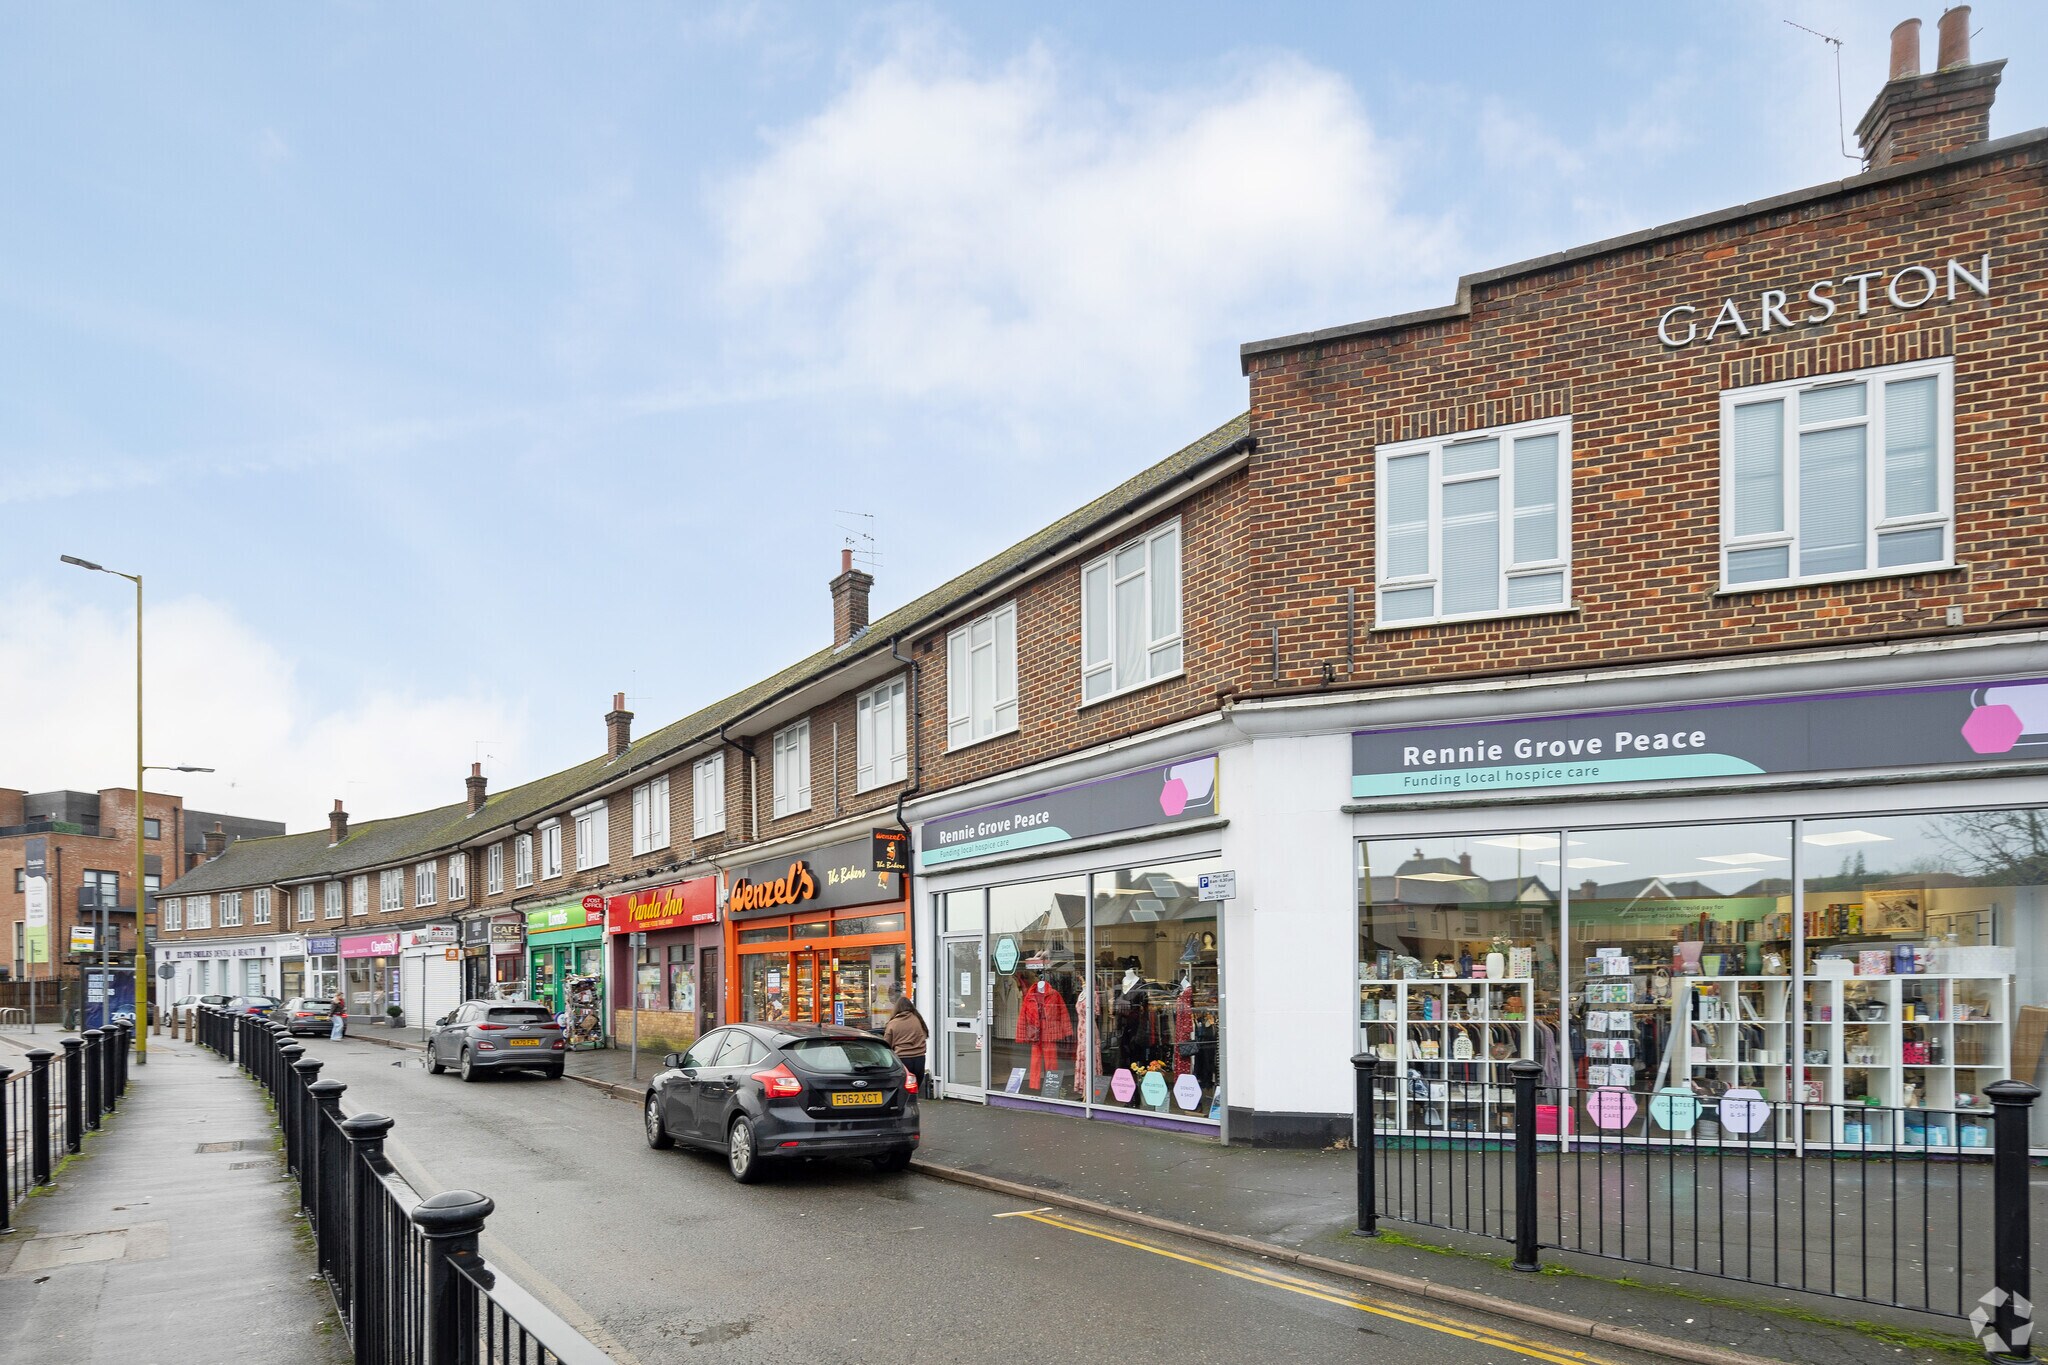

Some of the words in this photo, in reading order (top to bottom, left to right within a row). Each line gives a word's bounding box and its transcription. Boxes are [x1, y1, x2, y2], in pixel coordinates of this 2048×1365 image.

[1657, 253, 1990, 347] GARSTON
[1403, 740, 1503, 766] Rennie
[1514, 737, 1602, 759] Grove
[1615, 730, 1706, 753] Peace
[1403, 773, 1461, 787] Funding
[1466, 770, 1501, 783] local
[1505, 767, 1562, 782] hospice
[1568, 766, 1600, 777] care
[876, 832, 906, 841] Wenzel's
[940, 825, 974, 844] Rennie
[978, 819, 1011, 836] Grove
[1014, 811, 1049, 829] Peace
[940, 849, 960, 858] Funding
[961, 847, 973, 855] local
[975, 842, 996, 852] hospice
[997, 839, 1009, 847] care
[828, 868, 839, 886] The
[840, 865, 867, 884] Bakers
[887, 861, 906, 869] Bakers
[730, 860, 814, 912] Wenzel's
[628, 892, 662, 923] Panda
[663, 888, 685, 917] Inn
[493, 923, 520, 934] CAFÉ
[238, 948, 256, 956] BEAUTY
[836, 1094, 859, 1104] FD62
[861, 1093, 878, 1103] XCT
